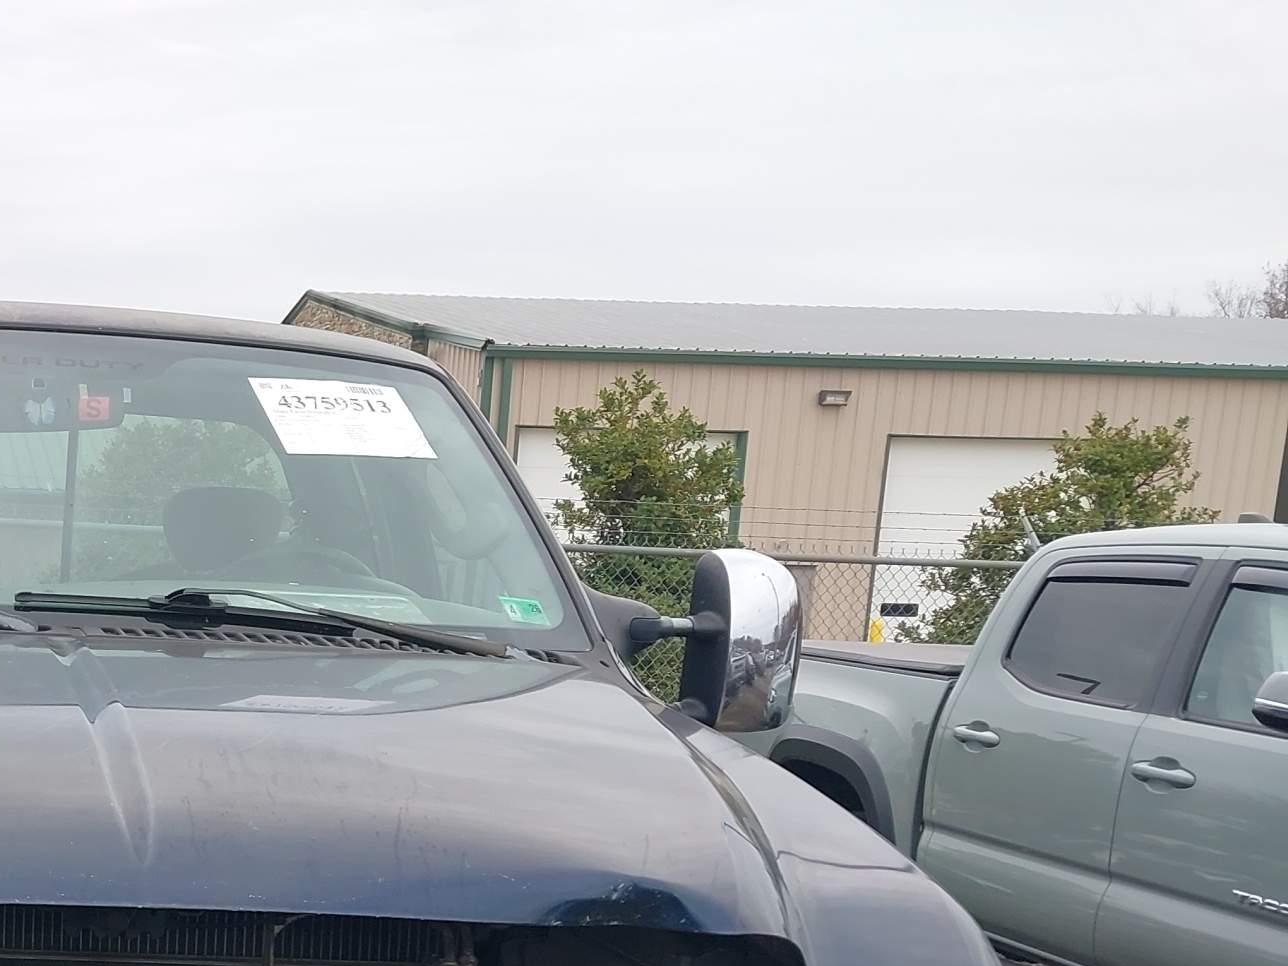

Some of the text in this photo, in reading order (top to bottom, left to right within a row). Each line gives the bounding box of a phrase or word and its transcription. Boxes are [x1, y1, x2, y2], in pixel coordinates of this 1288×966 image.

[54, 358, 145, 370] DUTY
[86, 399, 102, 418] S
[278, 395, 392, 414] 43759513
